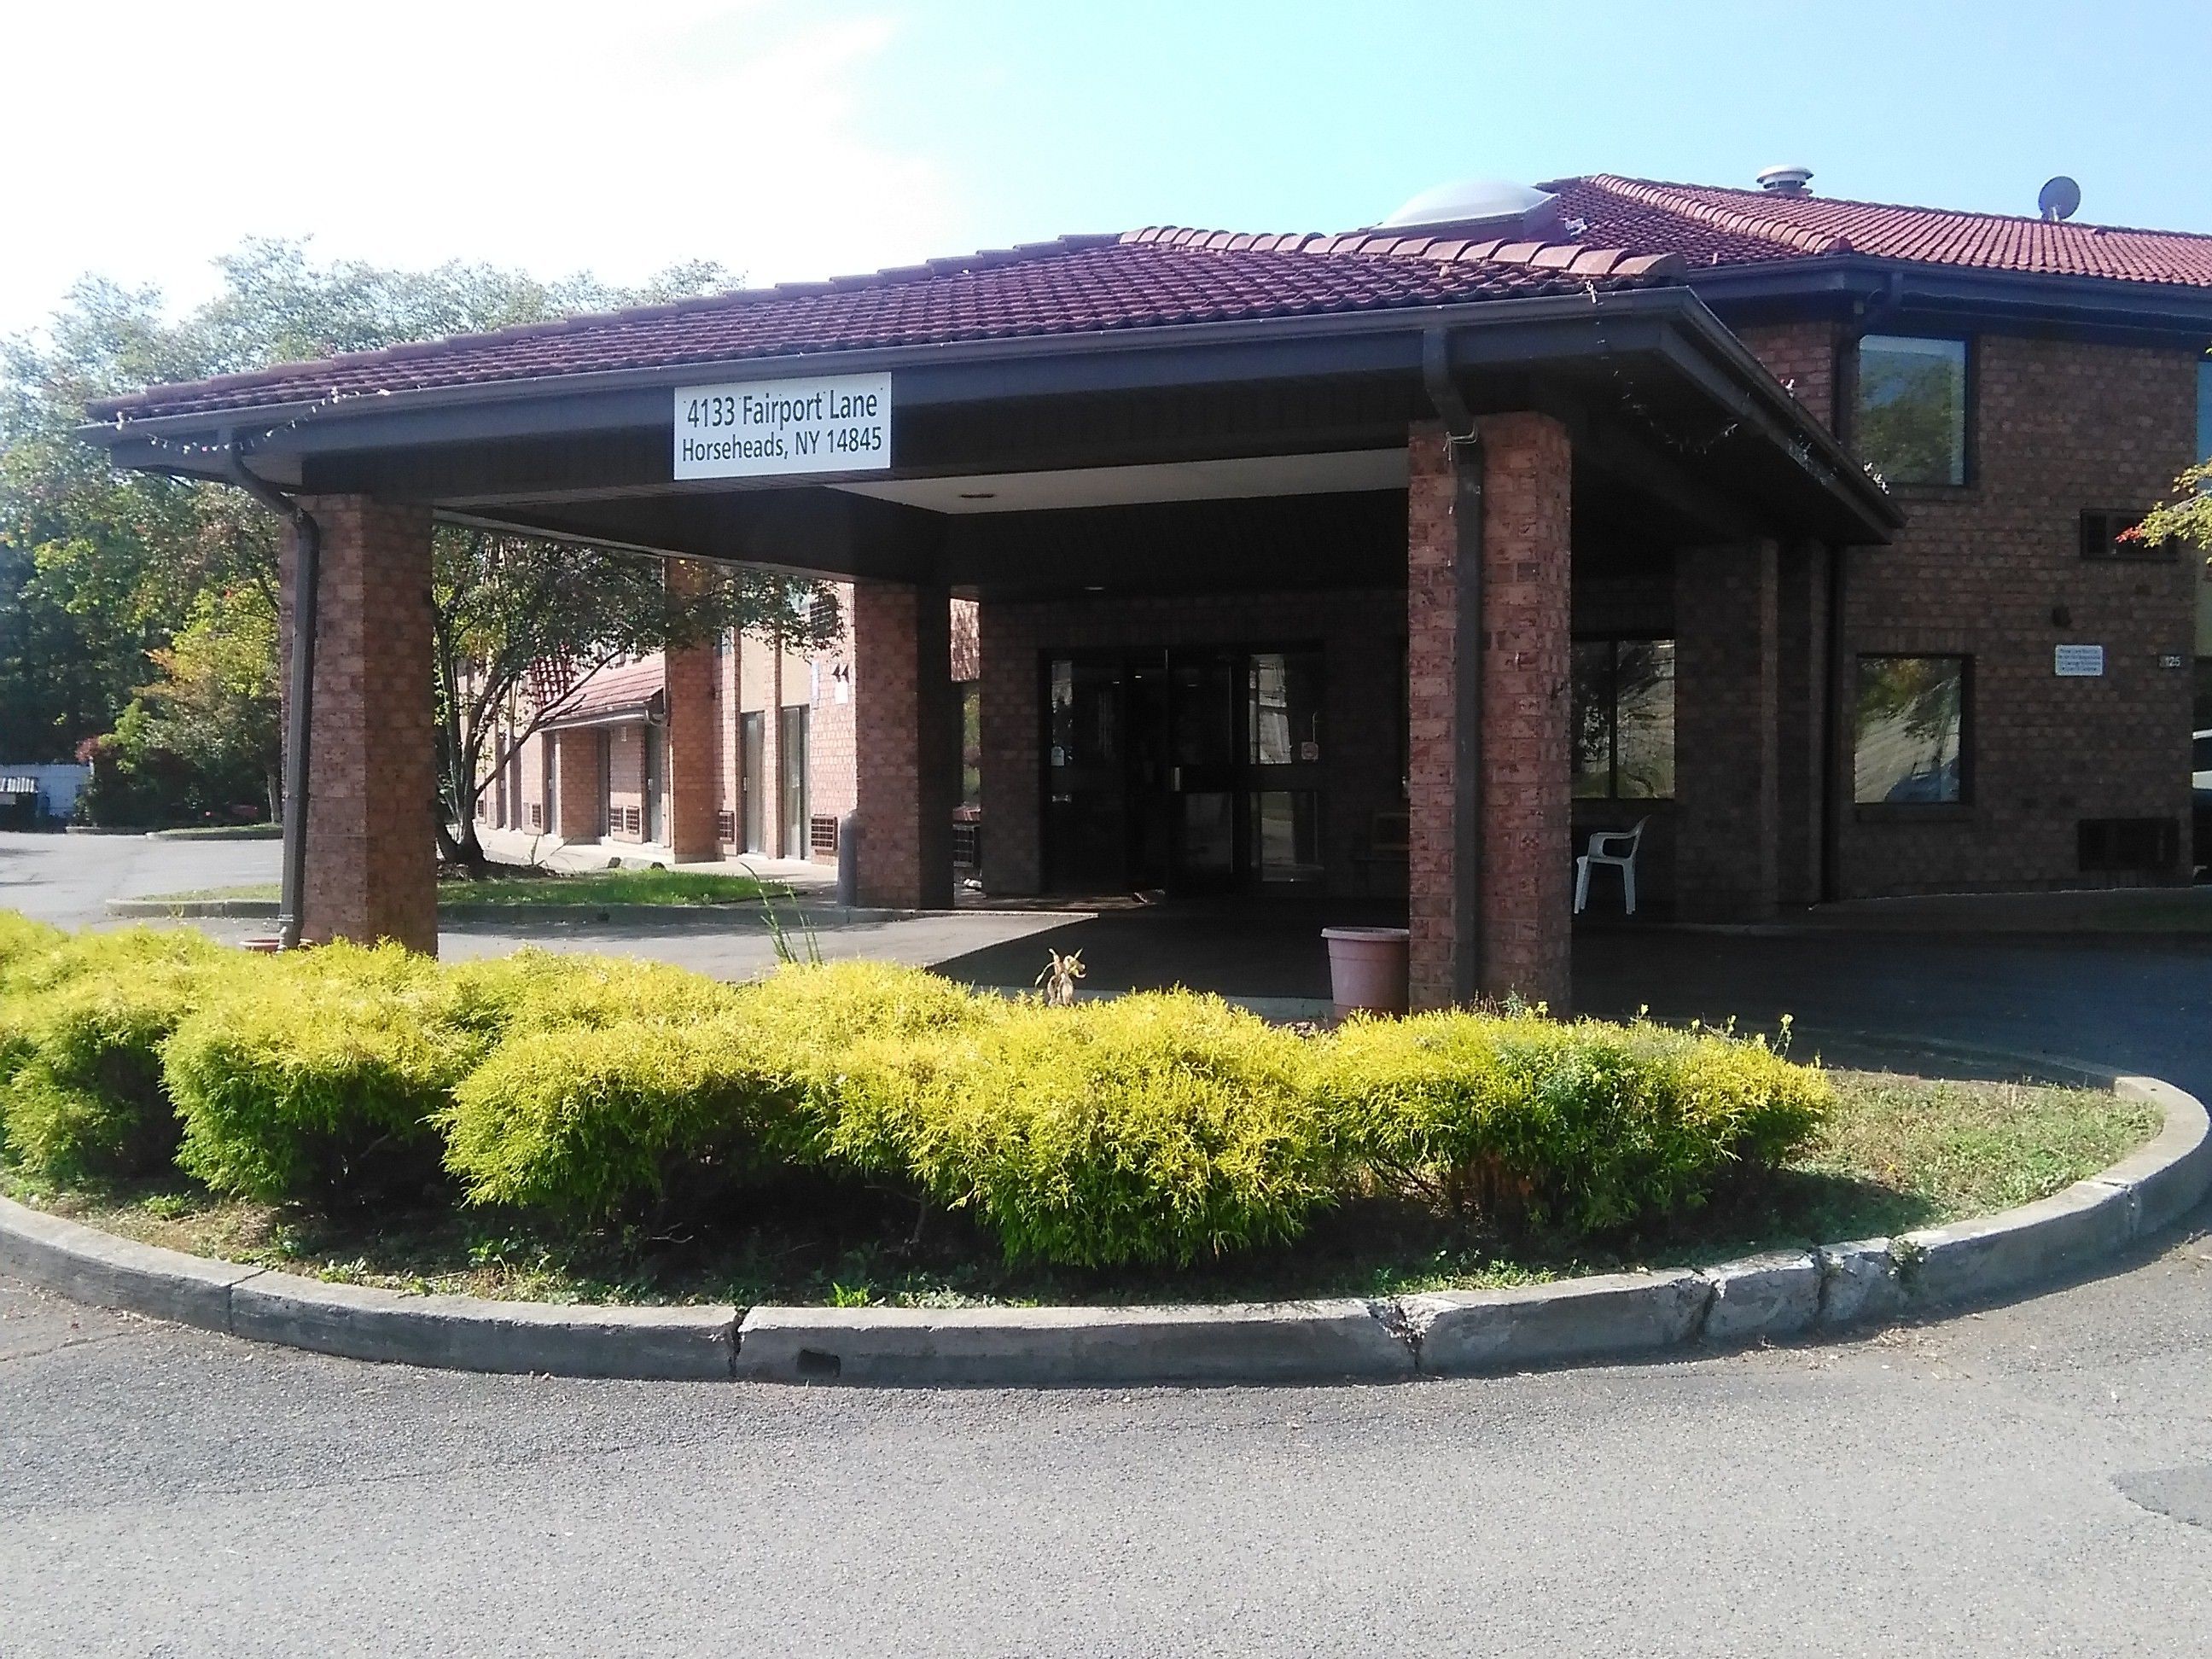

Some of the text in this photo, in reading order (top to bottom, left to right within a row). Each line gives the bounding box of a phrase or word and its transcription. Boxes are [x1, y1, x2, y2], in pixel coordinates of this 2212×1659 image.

[687, 390, 877, 430] 4133 Fairport Lane
[683, 427, 882, 460] Horseheads, NY 14845
